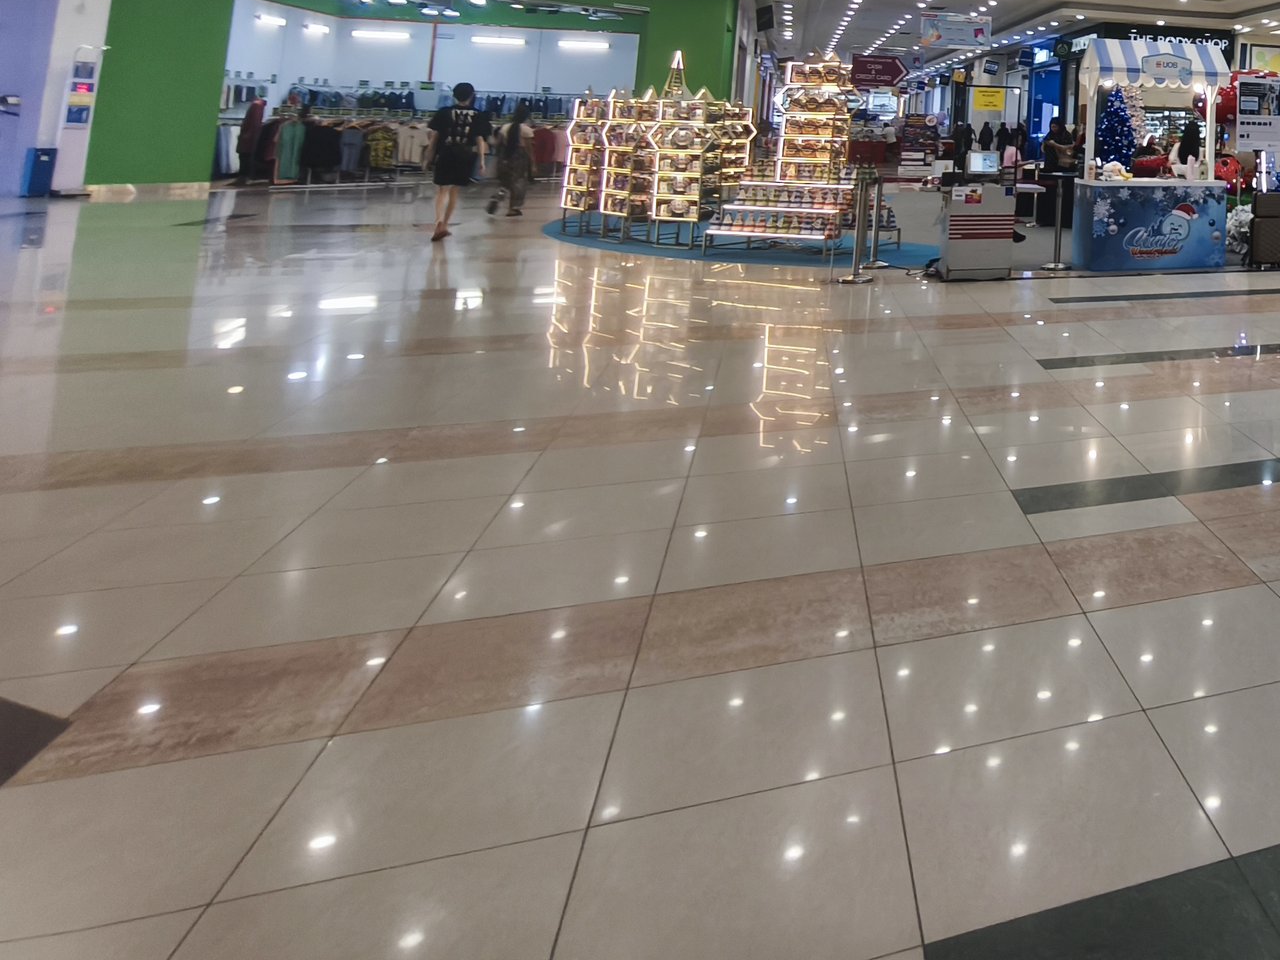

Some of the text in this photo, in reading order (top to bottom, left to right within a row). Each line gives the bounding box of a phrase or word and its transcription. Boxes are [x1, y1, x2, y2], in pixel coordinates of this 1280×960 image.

[1128, 33, 1230, 51] THE BODY SHOP
[1162, 60, 1179, 69] UOB
[876, 74, 892, 82] CARD
